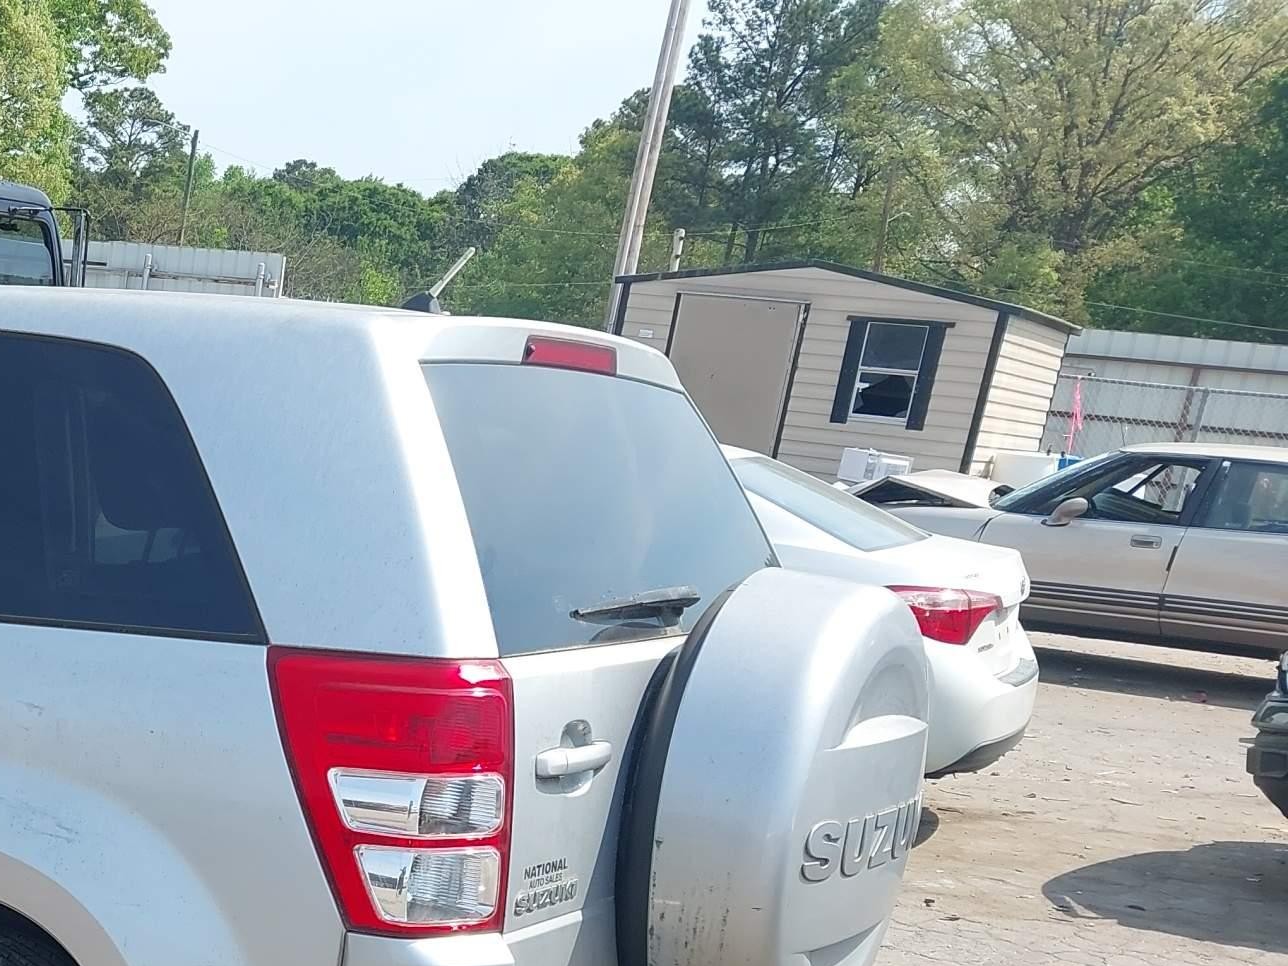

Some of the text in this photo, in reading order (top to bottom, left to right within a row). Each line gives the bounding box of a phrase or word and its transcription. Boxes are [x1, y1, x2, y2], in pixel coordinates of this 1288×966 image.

[799, 790, 923, 884] SUZU
[523, 858, 568, 880] NATIONAL
[529, 873, 563, 890] AUTO SALES
[514, 879, 579, 917] SUZUKI
